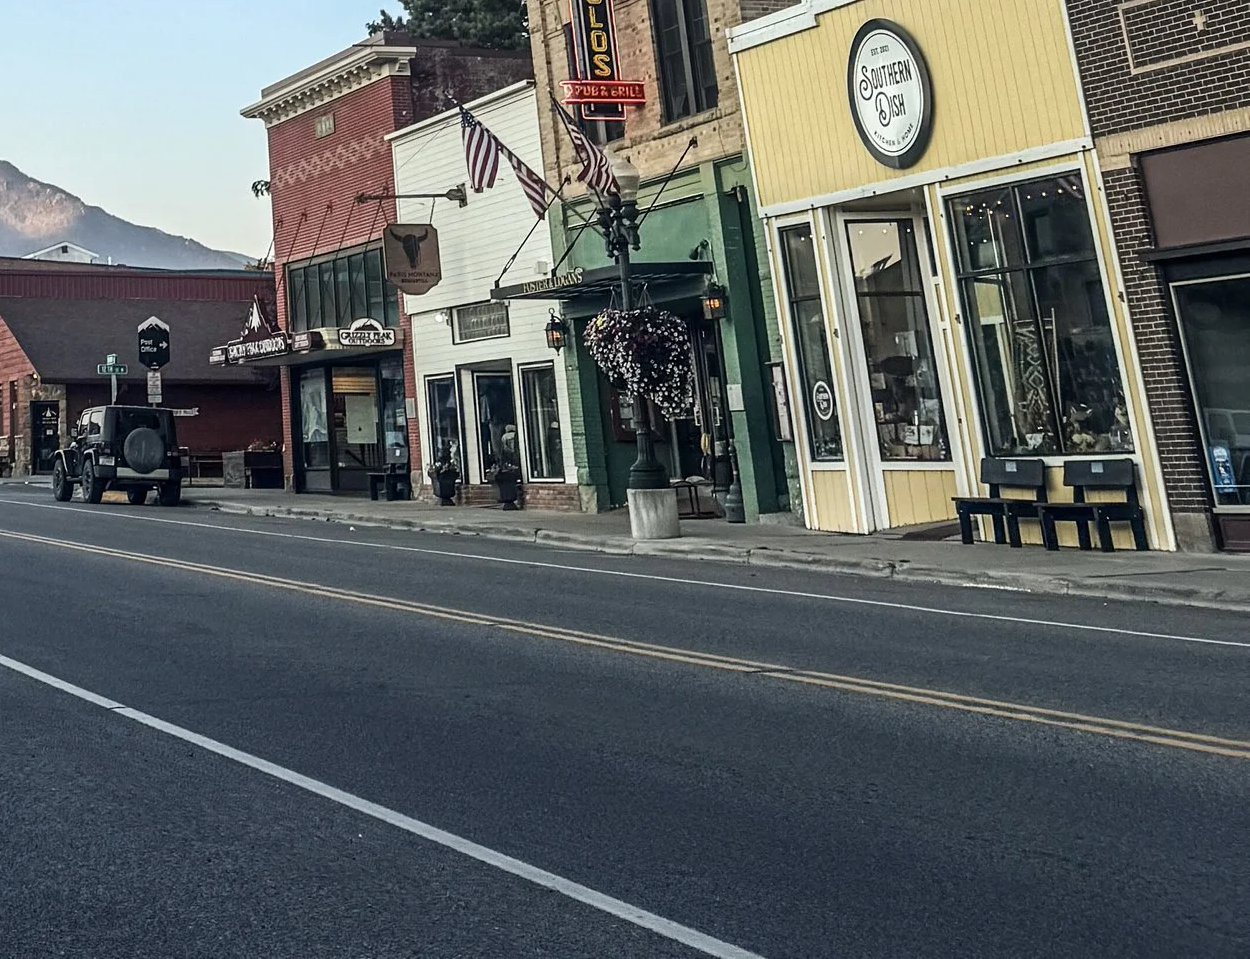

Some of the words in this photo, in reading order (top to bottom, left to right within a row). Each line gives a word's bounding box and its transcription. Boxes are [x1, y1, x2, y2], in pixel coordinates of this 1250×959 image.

[575, 85, 599, 97] PUB
[610, 85, 642, 98] GRILL
[859, 59, 912, 101] SOUTHERN
[875, 92, 906, 127] DISH
[341, 331, 371, 341] GRIZZLY
[373, 331, 392, 341] PEAK
